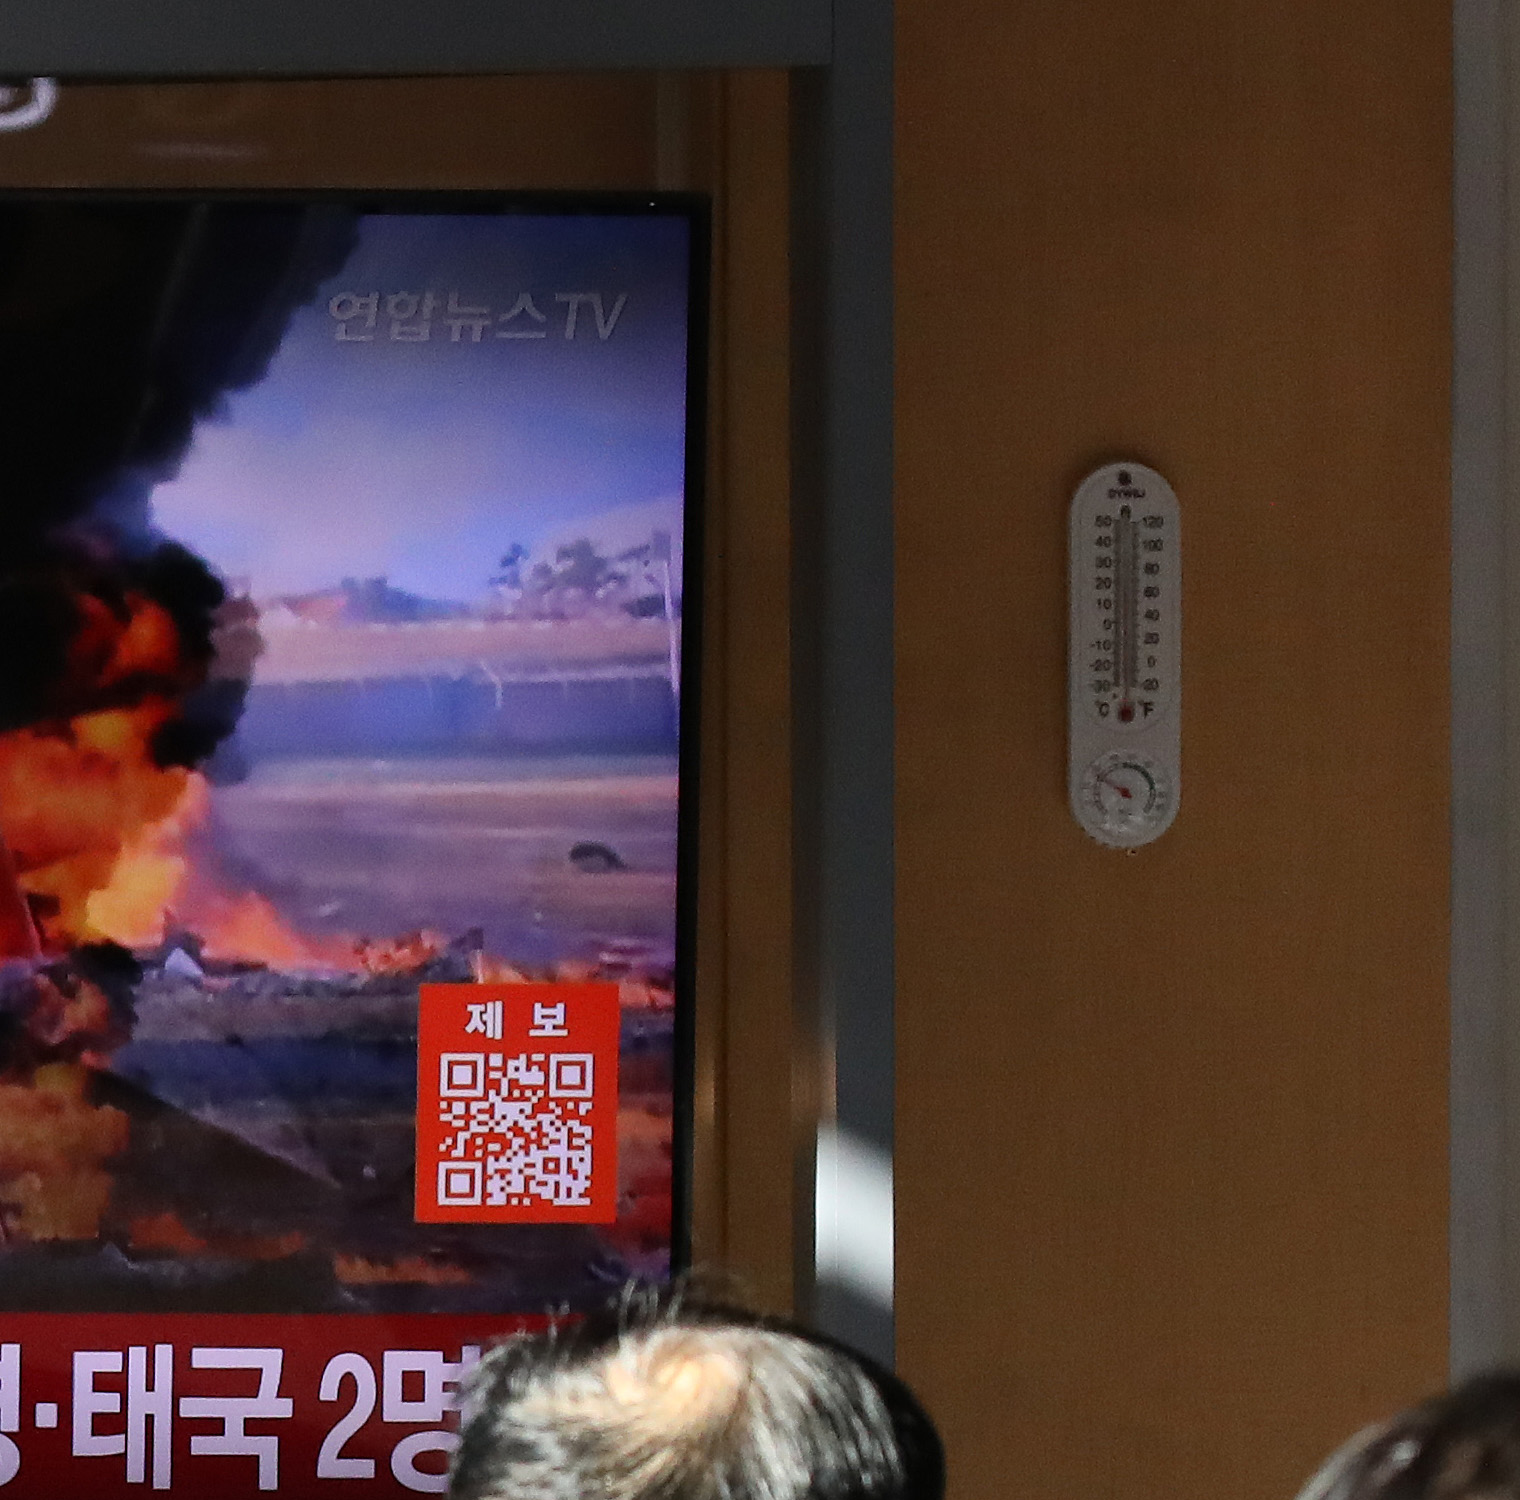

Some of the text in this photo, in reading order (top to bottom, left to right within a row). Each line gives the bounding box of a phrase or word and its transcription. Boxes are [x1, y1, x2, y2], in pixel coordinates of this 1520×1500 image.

[328, 291, 628, 342] 연합뉴스TV
[1095, 536, 1112, 548] 40
[1095, 577, 1112, 590] 20
[1097, 598, 1112, 610] 10
[1147, 655, 1157, 668] 0
[316, 1344, 481, 1493] 2명
